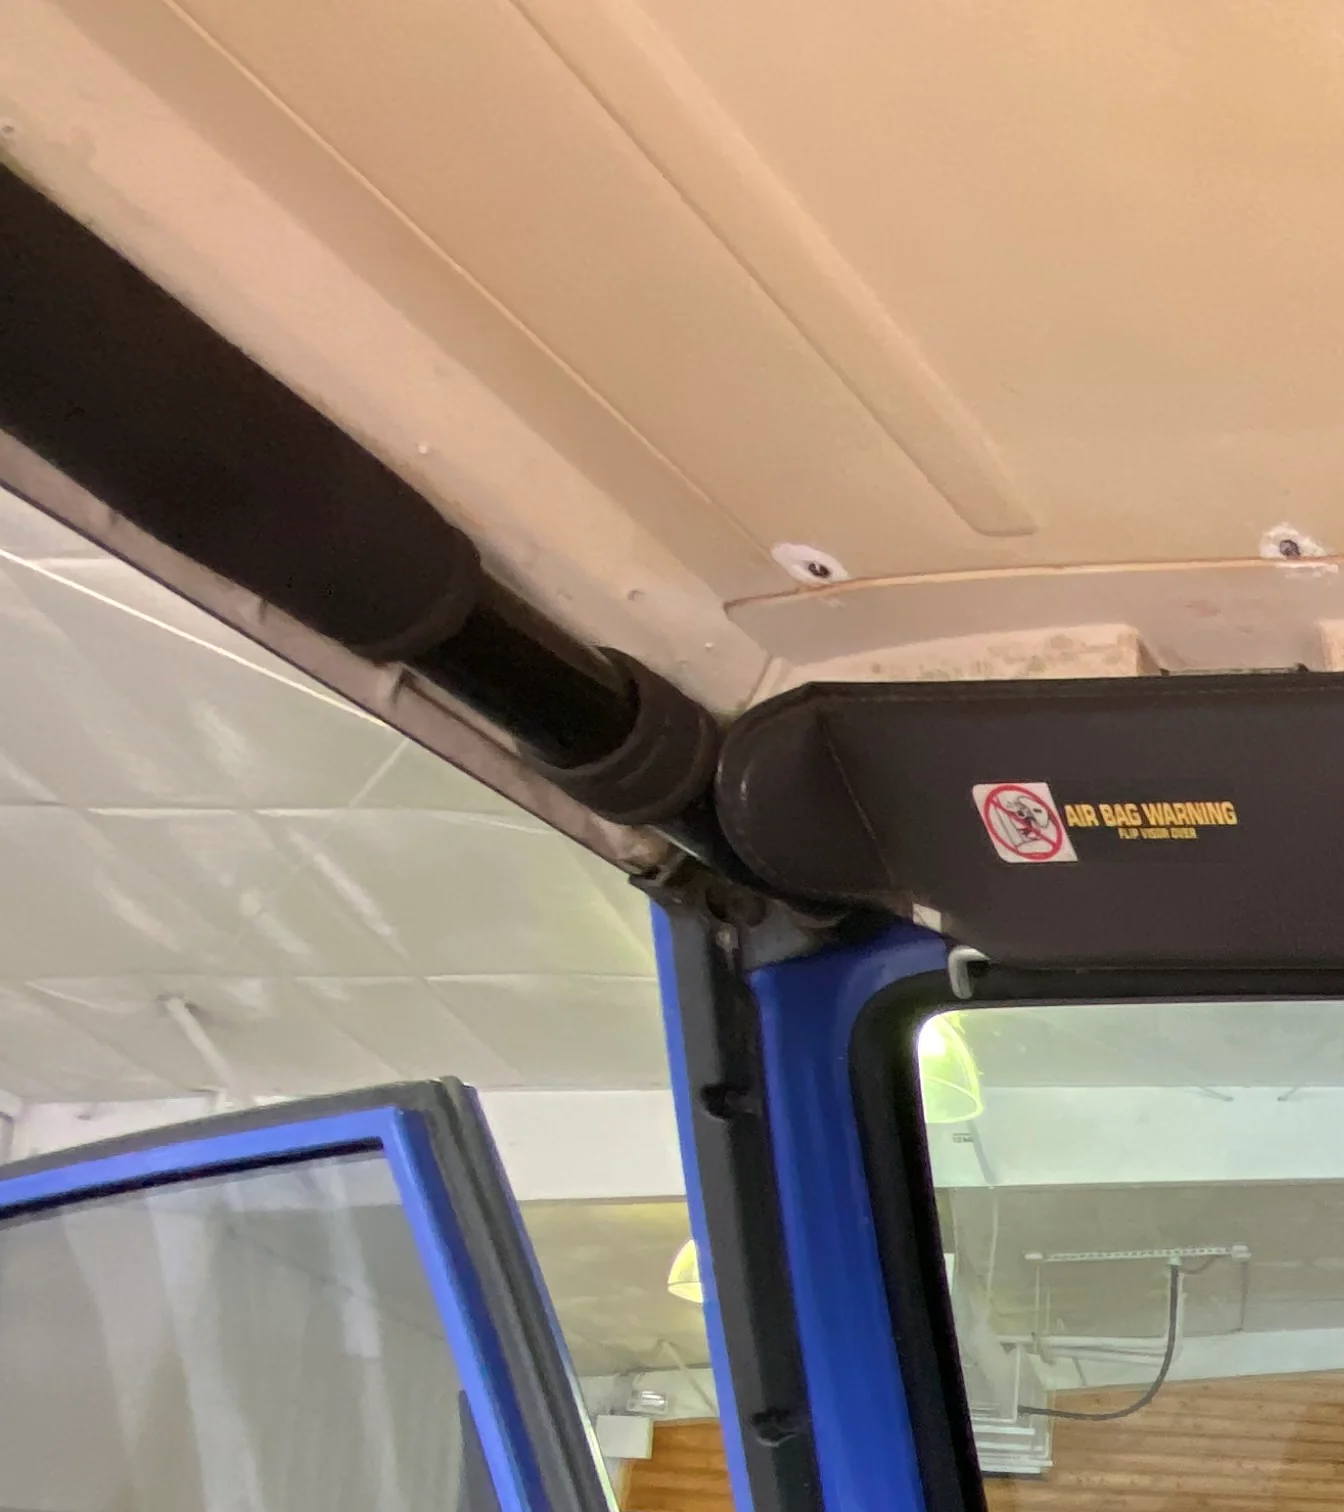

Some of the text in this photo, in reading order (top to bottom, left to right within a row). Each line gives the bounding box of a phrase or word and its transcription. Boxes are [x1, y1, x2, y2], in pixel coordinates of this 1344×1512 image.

[1064, 801, 1238, 827] AIR BAG WARNING
